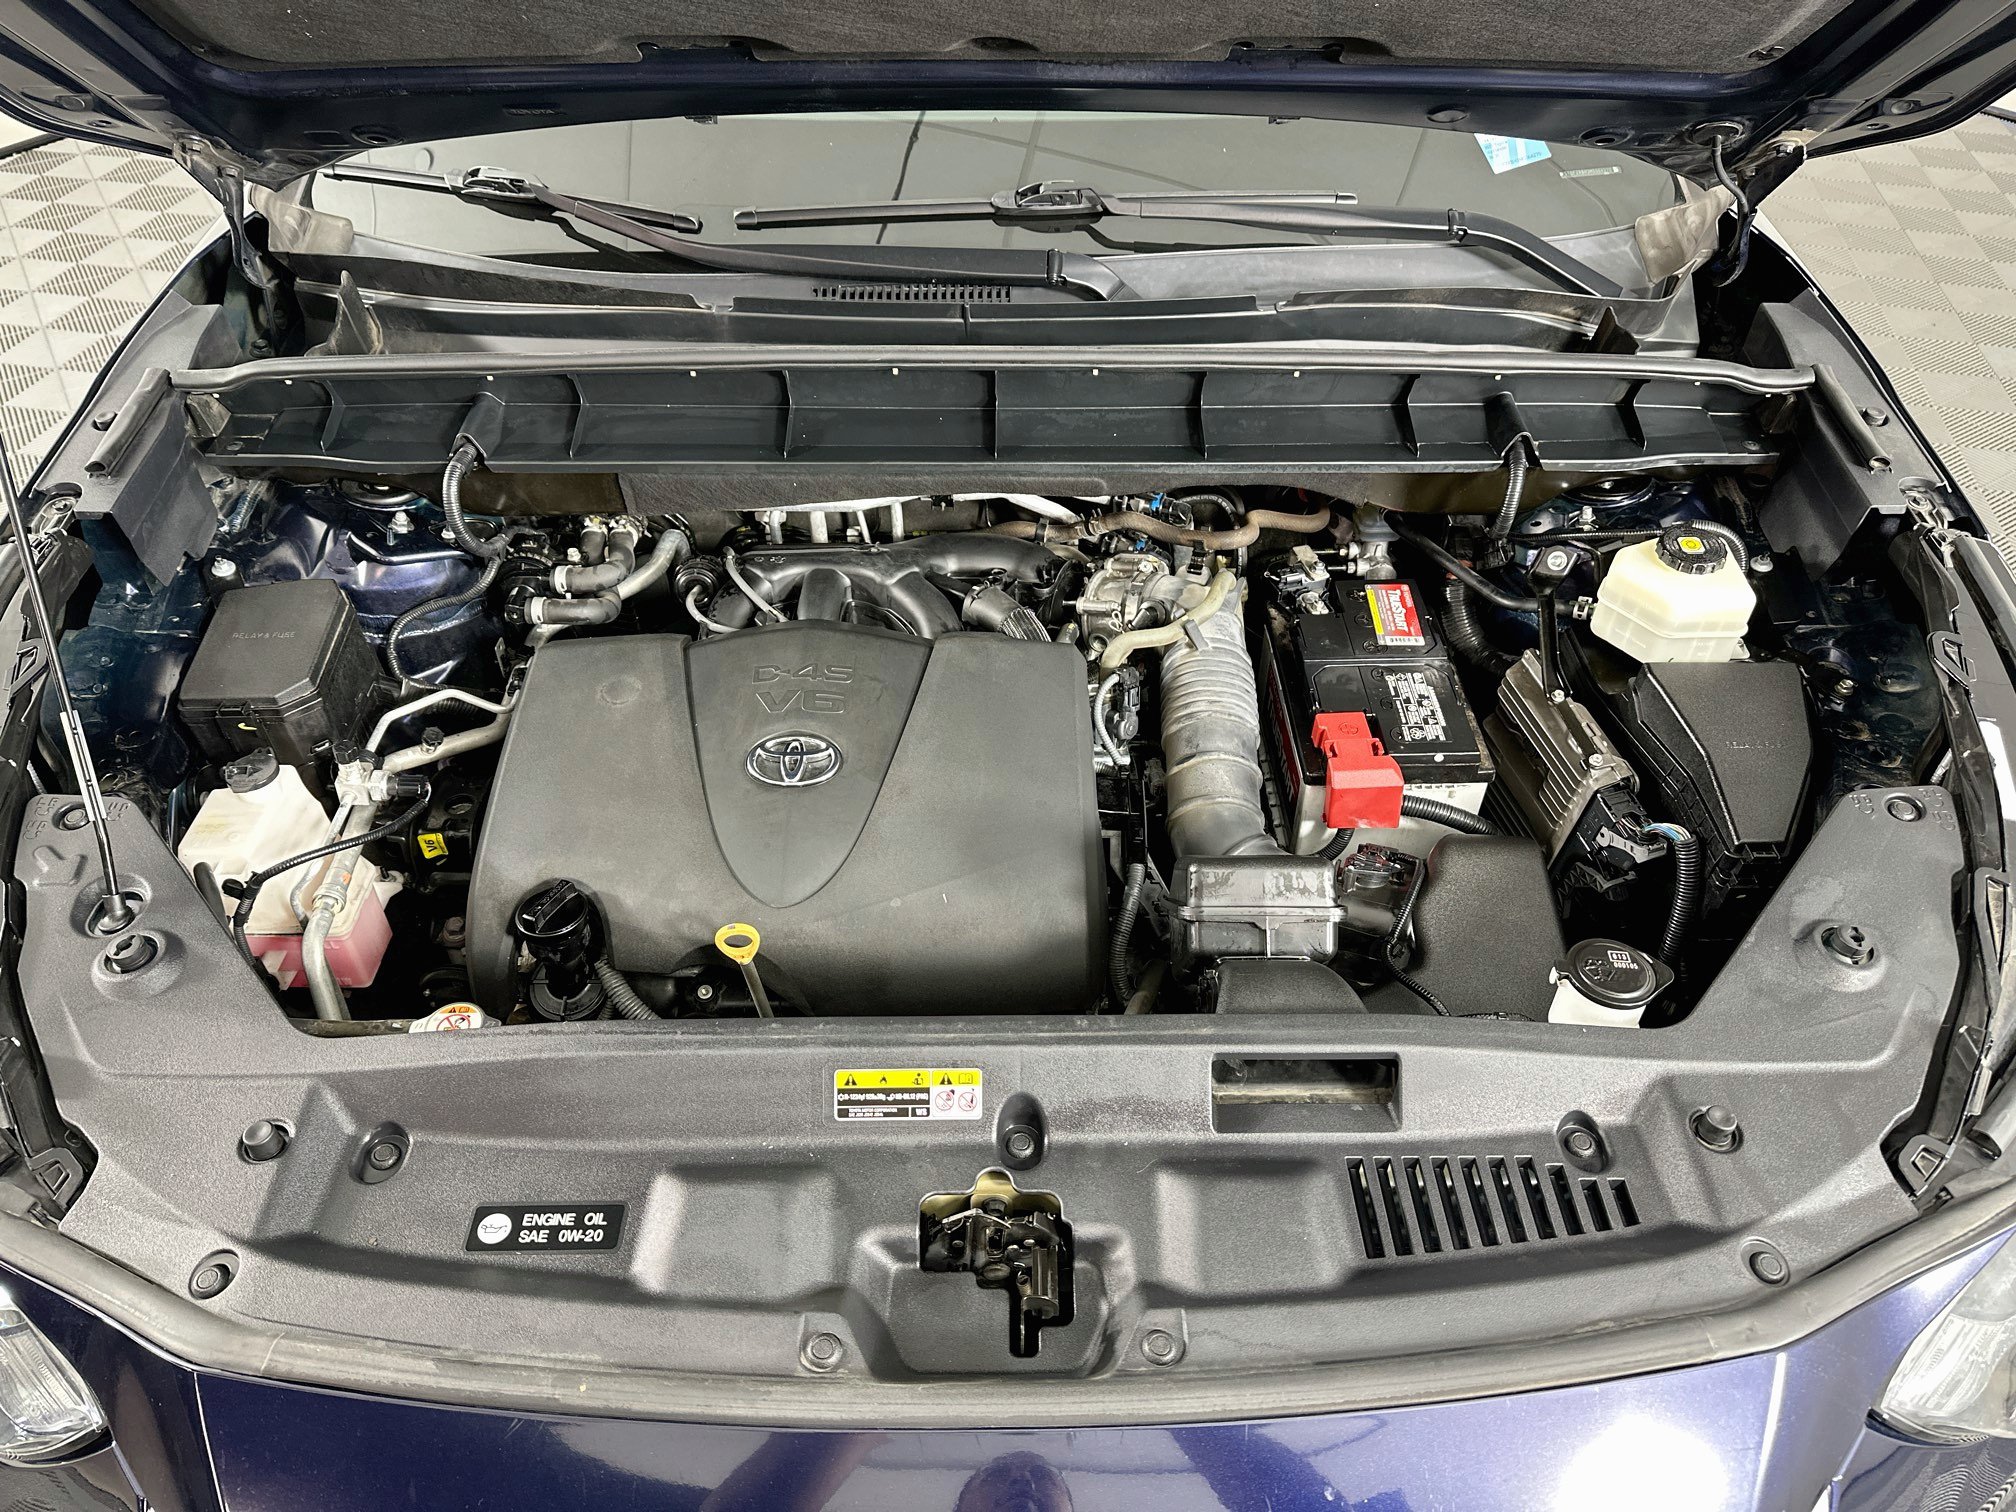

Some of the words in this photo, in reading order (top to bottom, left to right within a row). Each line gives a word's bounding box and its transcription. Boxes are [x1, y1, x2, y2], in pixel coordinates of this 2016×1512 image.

[752, 663, 854, 684] D-4S
[755, 690, 846, 713] V6
[522, 1213, 576, 1226] ENGINE
[584, 1212, 607, 1226] OIL
[518, 1230, 550, 1243] SAE
[558, 1229, 604, 1243] 0W-20
